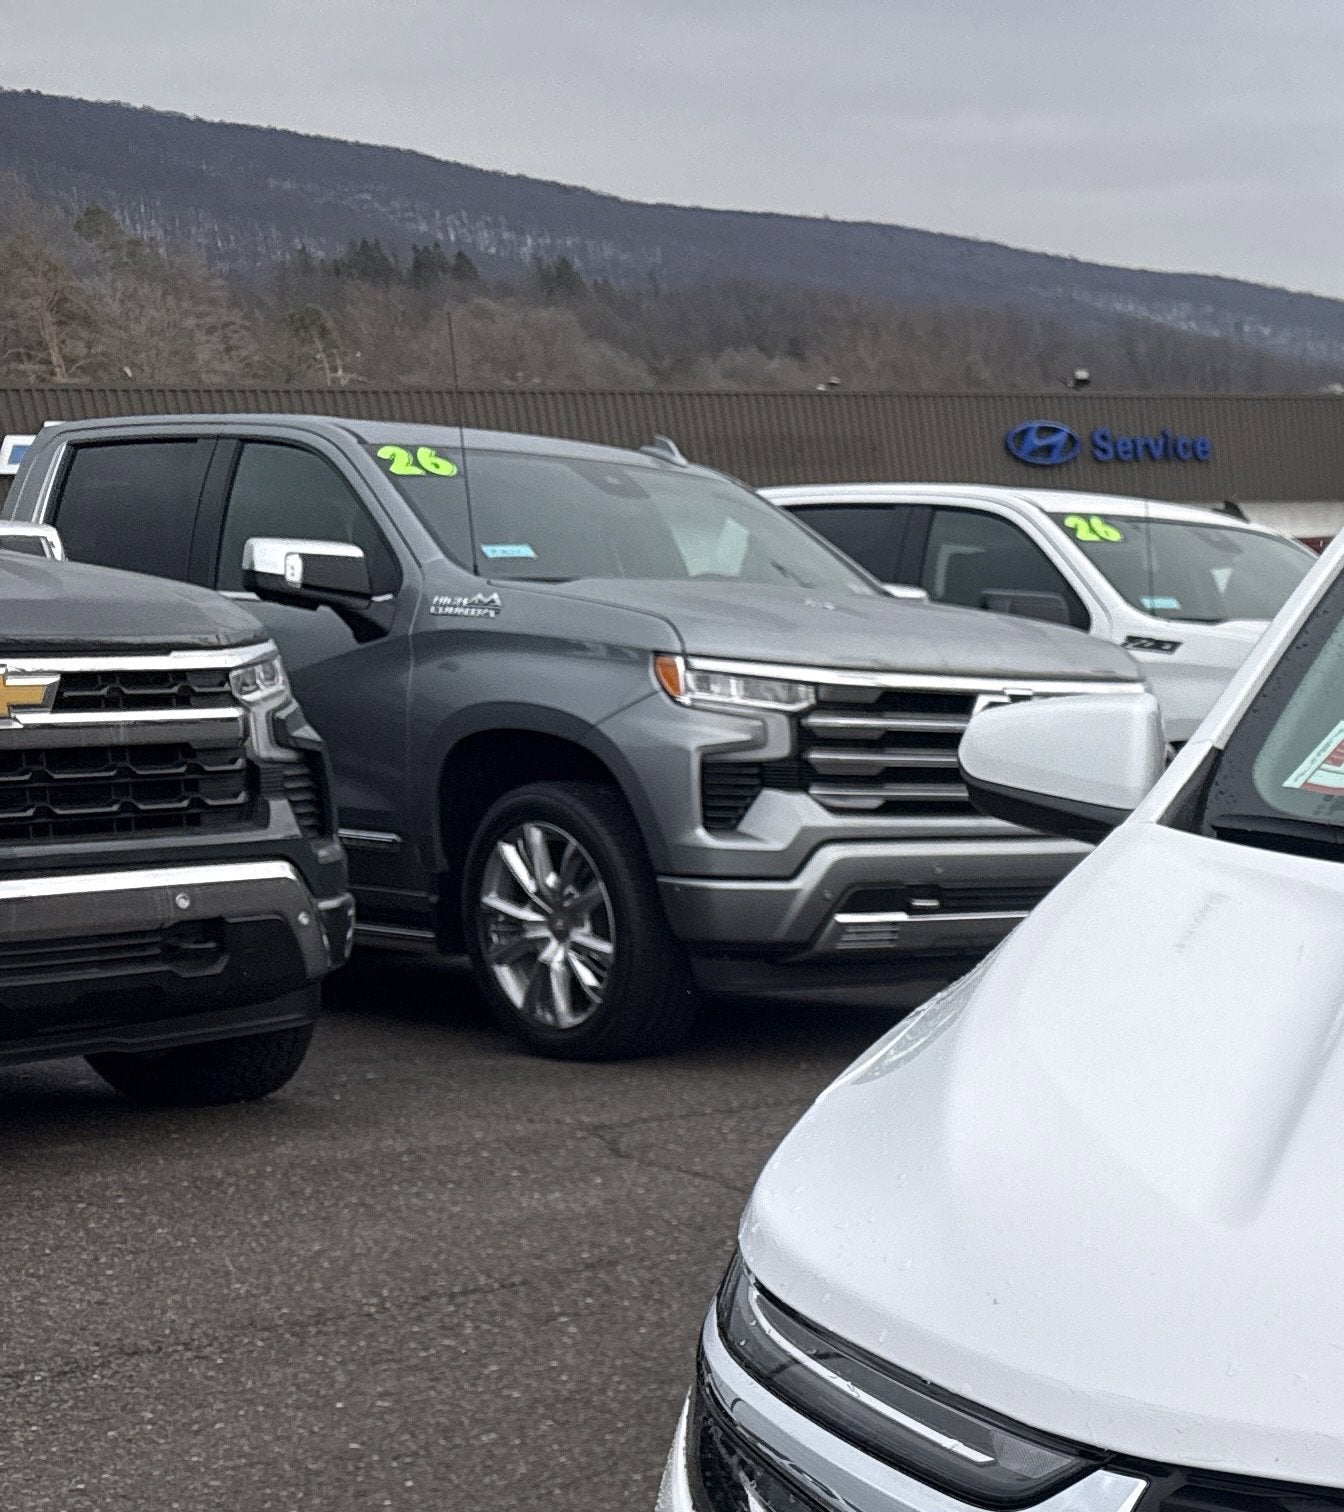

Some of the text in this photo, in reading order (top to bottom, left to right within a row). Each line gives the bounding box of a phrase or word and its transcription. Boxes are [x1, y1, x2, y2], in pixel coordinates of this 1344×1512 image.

[1092, 427, 1212, 462] Service
[377, 445, 458, 477] 26
[1064, 515, 1123, 542] 26
